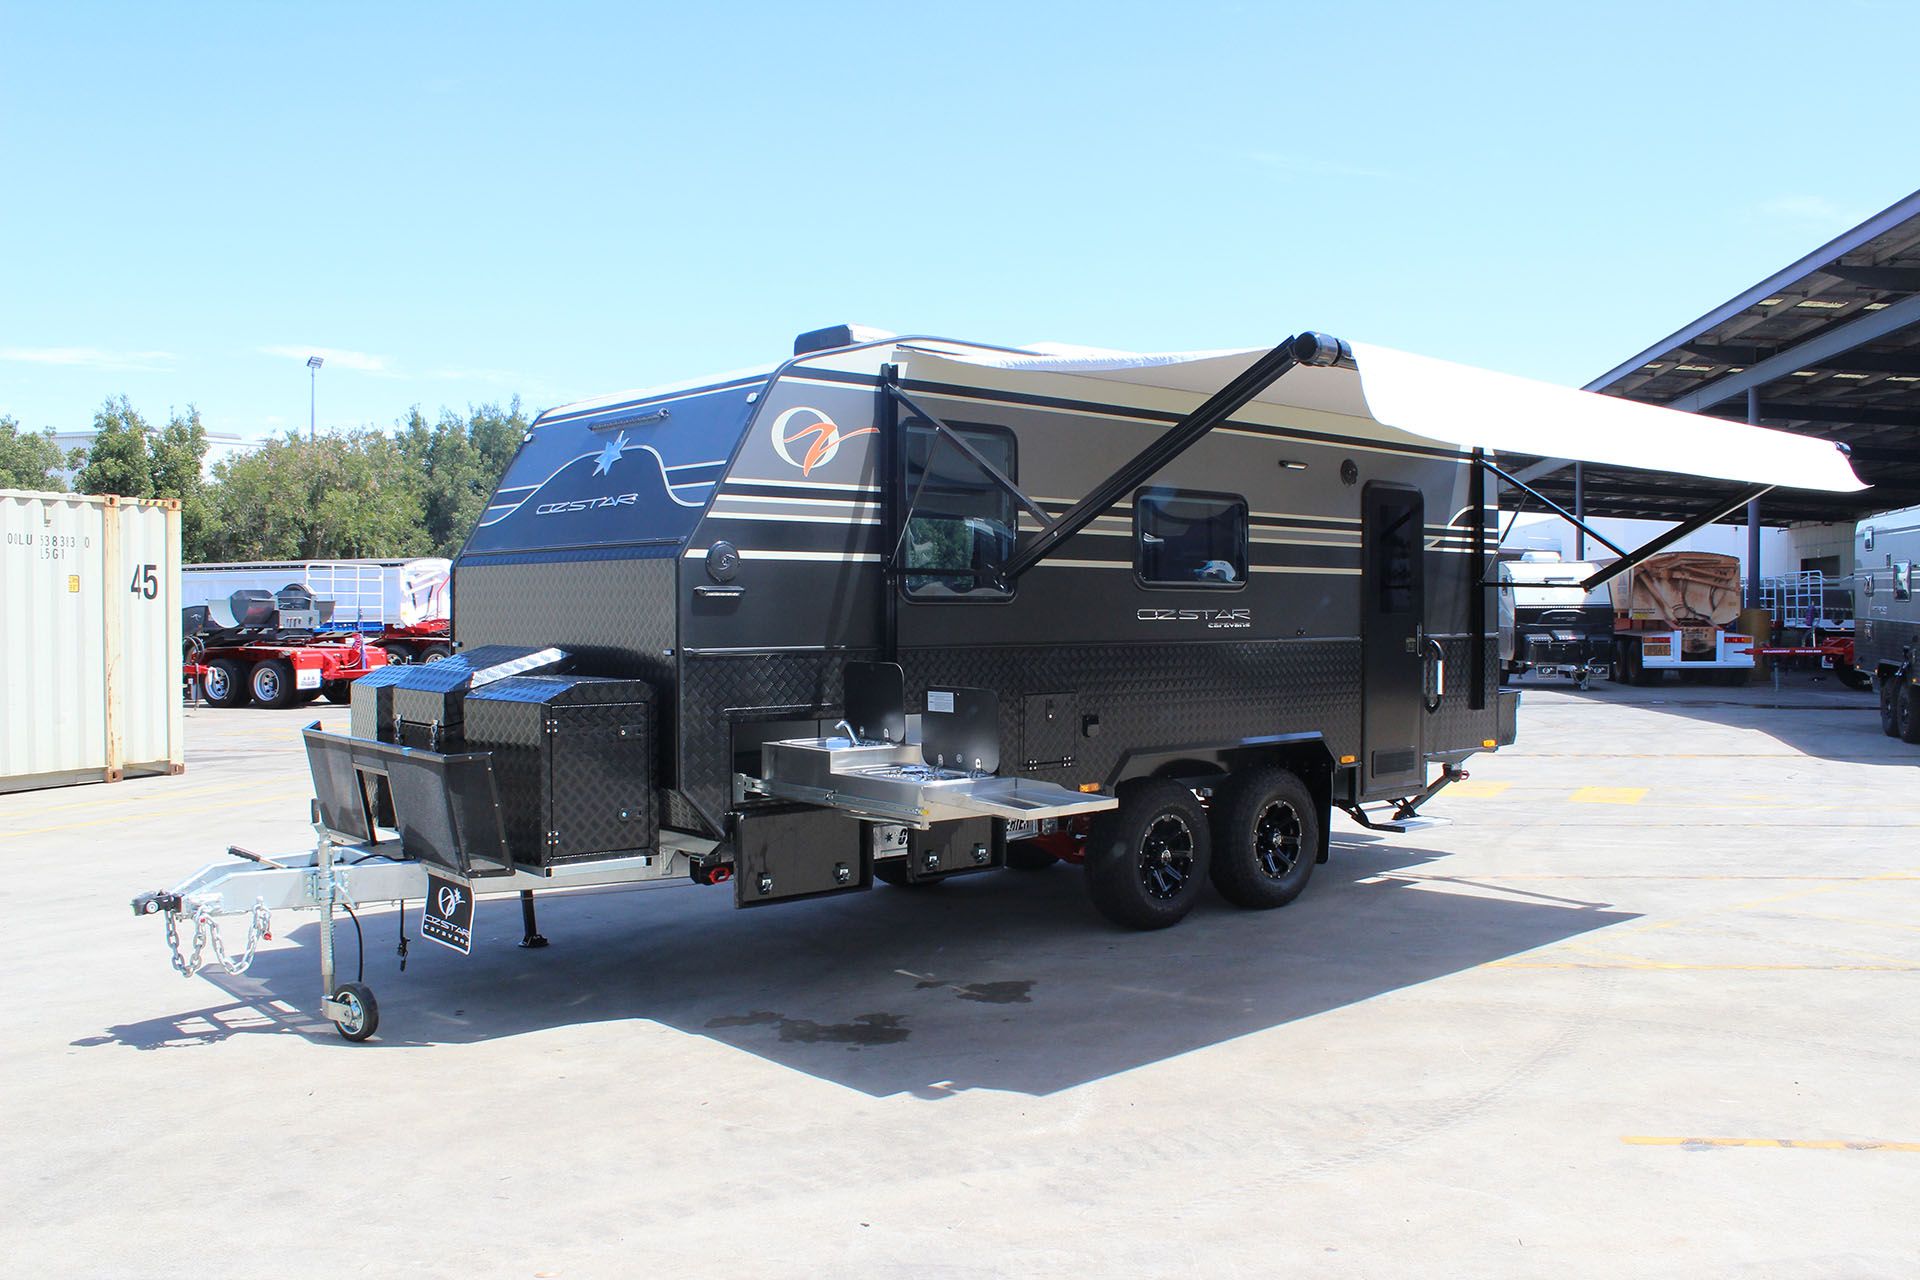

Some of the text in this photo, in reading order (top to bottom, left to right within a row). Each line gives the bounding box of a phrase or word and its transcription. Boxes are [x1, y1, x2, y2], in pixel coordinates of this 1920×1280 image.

[536, 493, 639, 515] OZSTAR
[130, 564, 158, 600] 45
[1137, 608, 1251, 620] OZSTAR
[425, 914, 470, 937] OZSTAR
